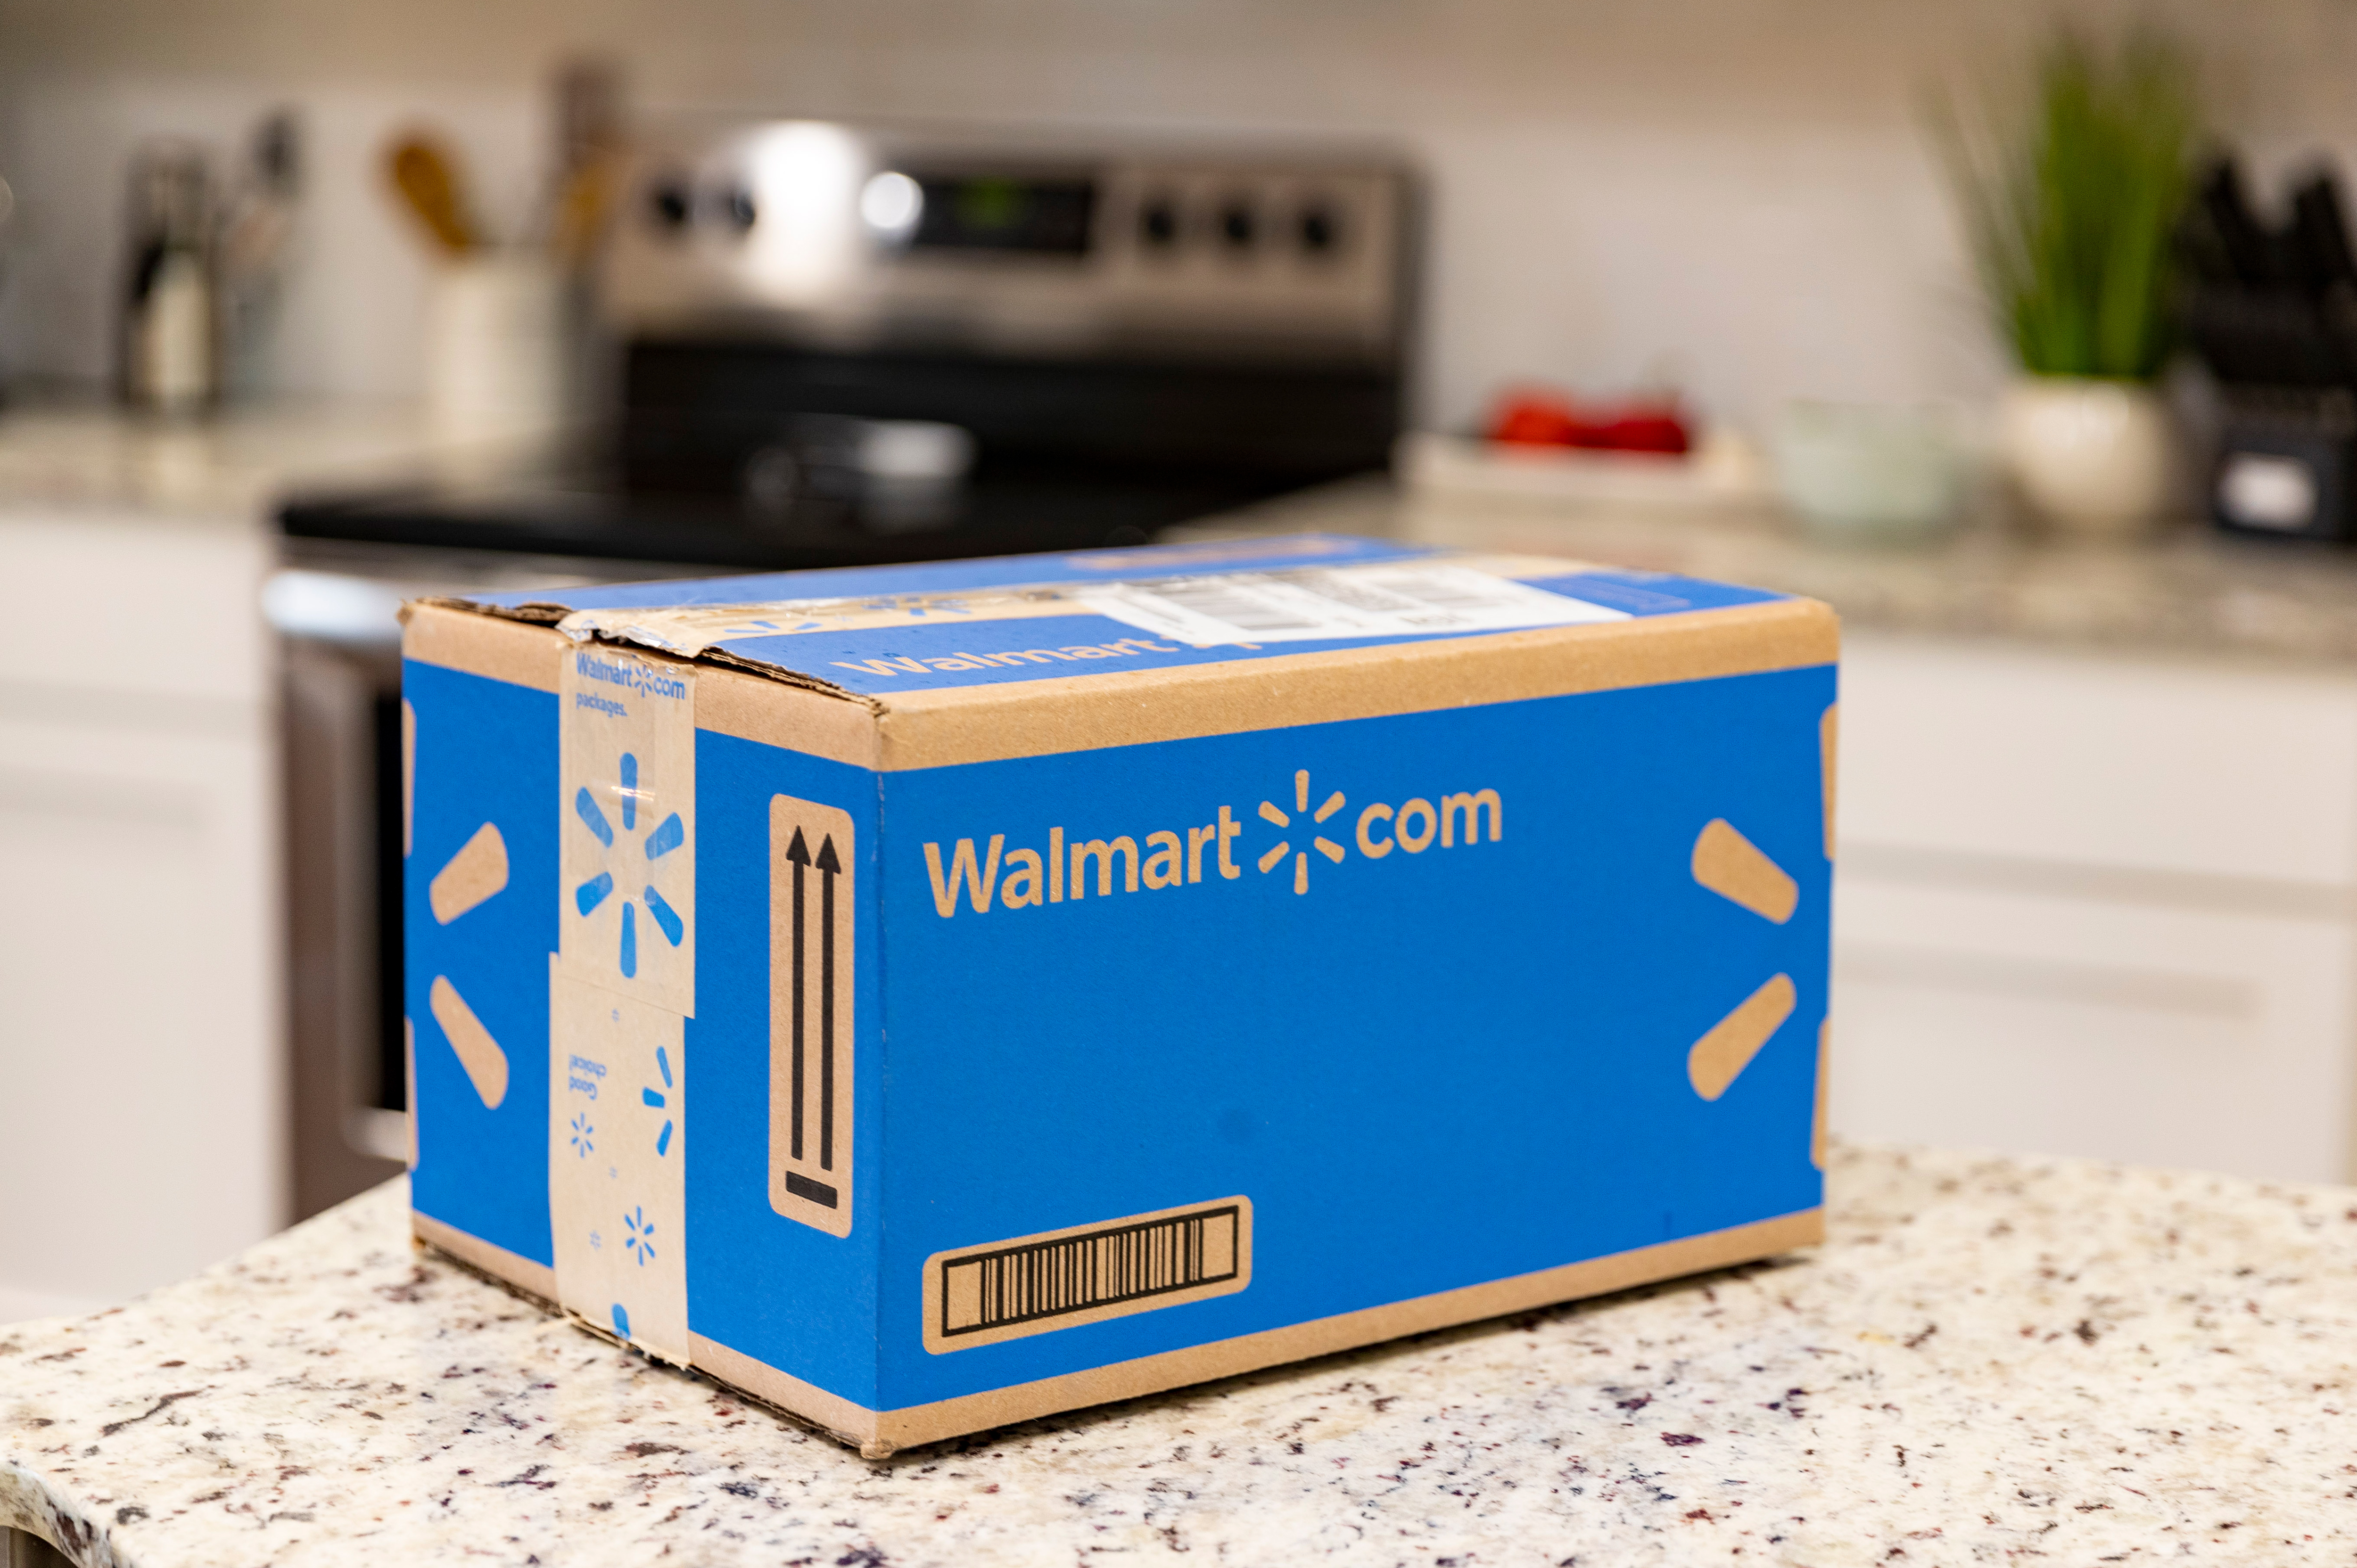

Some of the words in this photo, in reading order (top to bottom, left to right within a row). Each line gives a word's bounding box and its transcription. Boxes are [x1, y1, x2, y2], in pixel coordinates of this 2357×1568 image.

[577, 652, 632, 688] Walmart
[653, 676, 685, 700] com
[829, 637, 1179, 676] Walmart
[922, 805, 1241, 919] Walmart
[1356, 788, 1502, 859] com
[568, 1075, 598, 1101] Good
